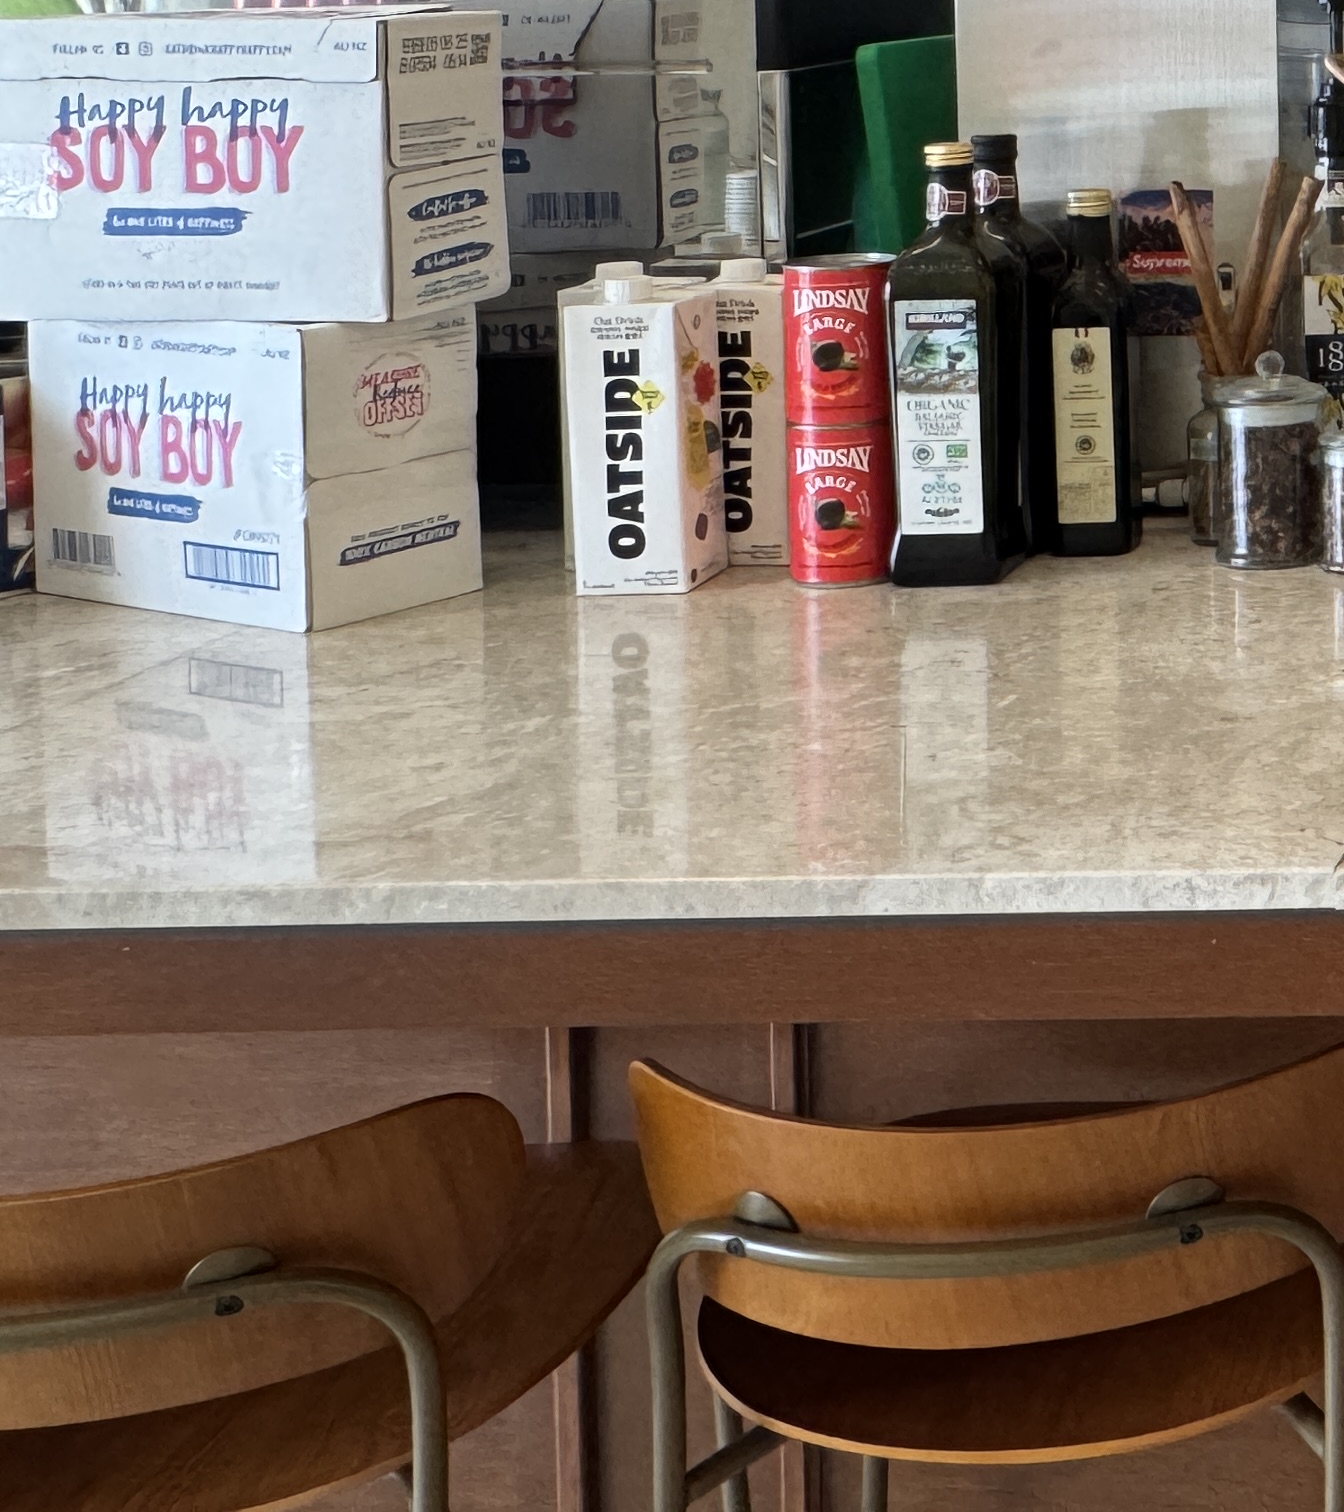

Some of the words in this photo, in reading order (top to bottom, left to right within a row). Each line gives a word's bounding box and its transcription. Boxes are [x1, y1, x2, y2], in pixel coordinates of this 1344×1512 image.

[56, 92, 165, 144] Happy
[181, 86, 289, 144] happy
[51, 125, 167, 192] SOY
[185, 125, 305, 194] BOY
[793, 287, 871, 316] LINDSAY
[80, 376, 149, 428] Happy
[159, 376, 232, 439] happy
[718, 330, 754, 533] OATSIDE
[75, 408, 150, 479] SOY
[160, 414, 243, 488] BOY
[603, 348, 646, 559] OATSIDE
[795, 444, 874, 475] LINDSAY
